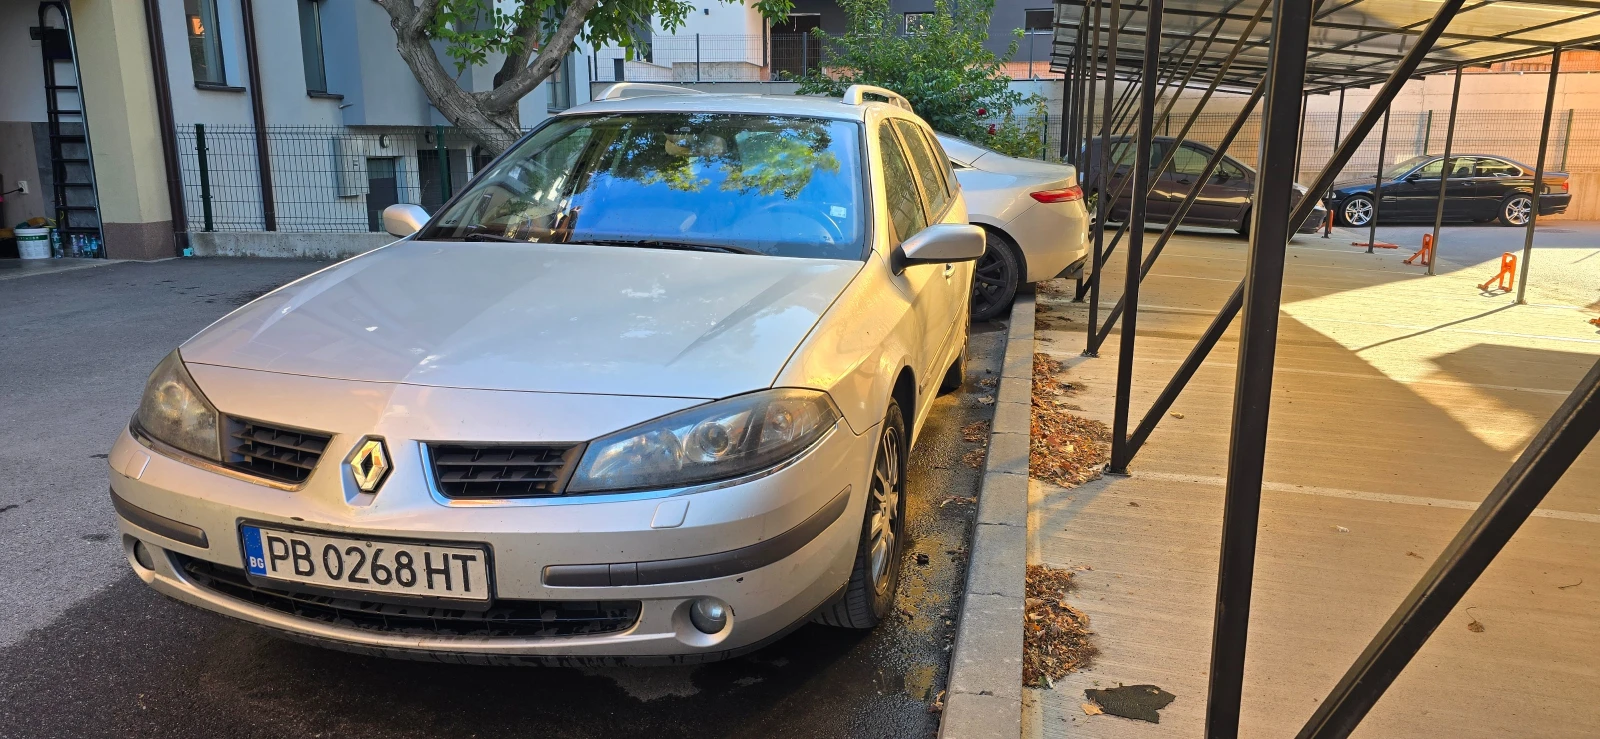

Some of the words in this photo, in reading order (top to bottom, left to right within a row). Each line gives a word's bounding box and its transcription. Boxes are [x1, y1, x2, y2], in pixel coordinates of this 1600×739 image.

[249, 556, 264, 569] BG
[267, 535, 315, 577] PB
[322, 543, 417, 588] 0268
[424, 551, 477, 592] HT
